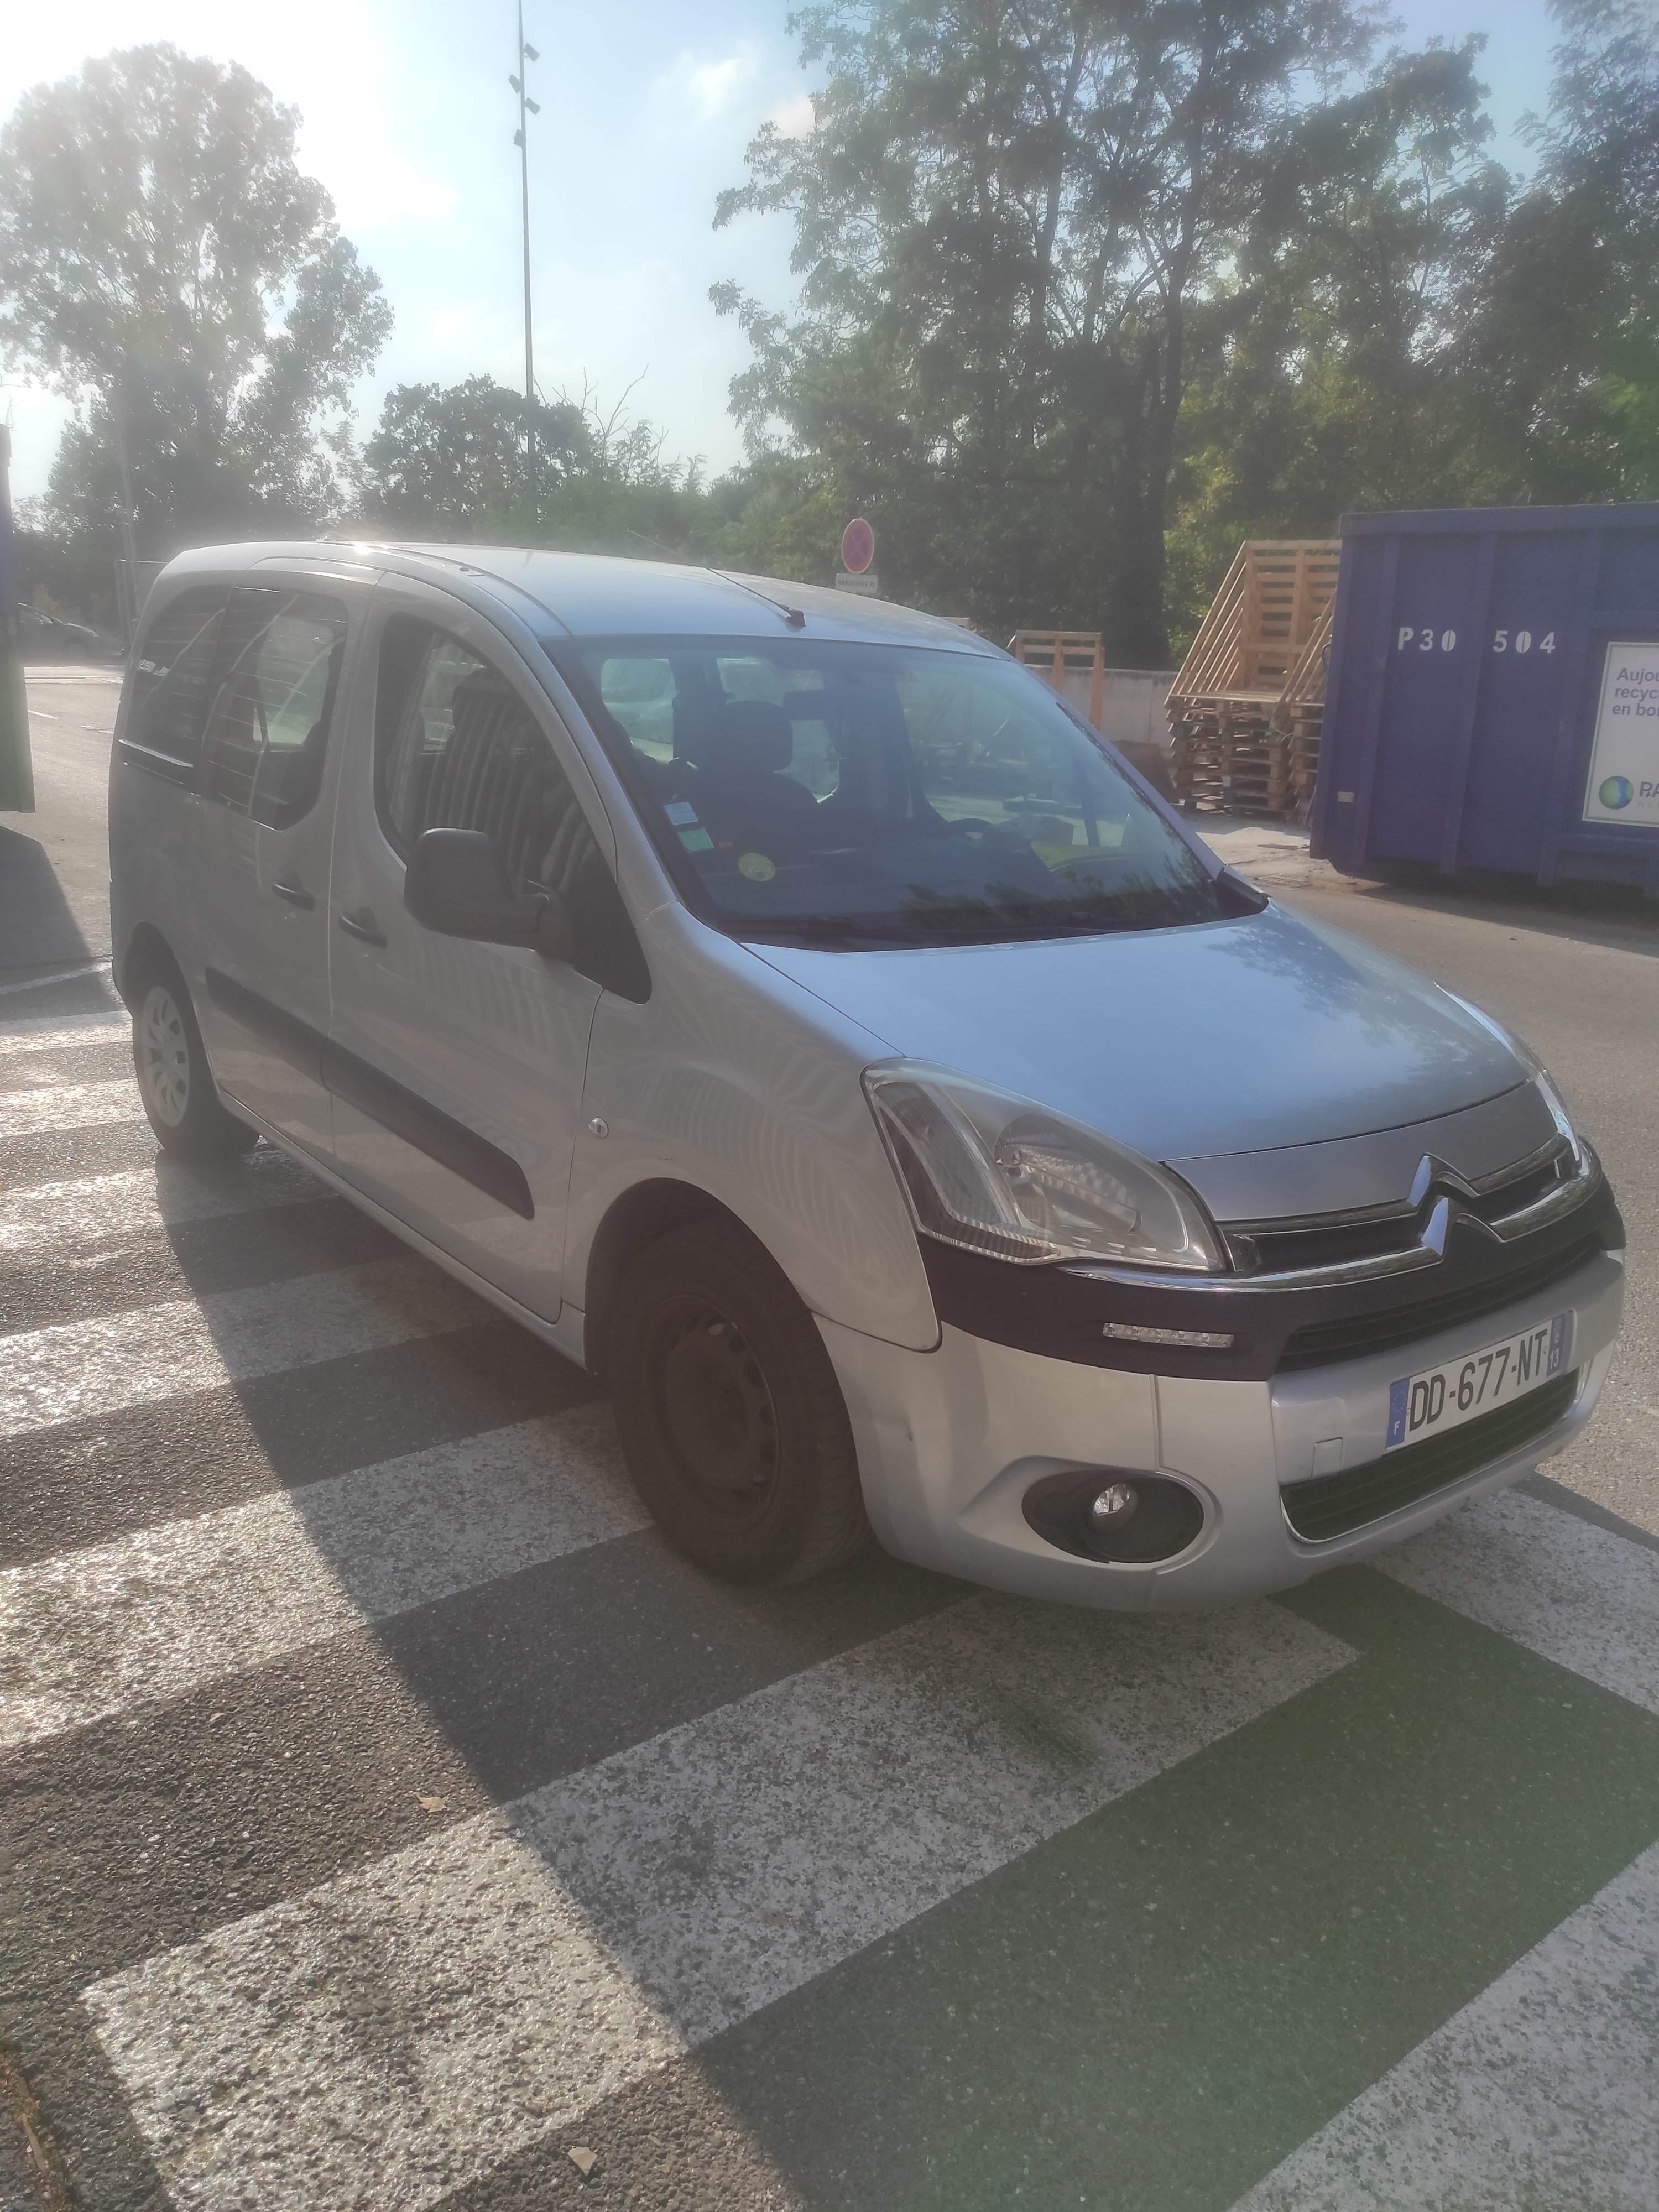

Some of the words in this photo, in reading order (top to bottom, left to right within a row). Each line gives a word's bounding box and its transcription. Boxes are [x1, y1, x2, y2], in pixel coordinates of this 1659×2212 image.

[1397, 627, 1456, 652] P30
[1493, 630, 1555, 654] 504
[1615, 688, 1659, 702] recyc
[1612, 705, 1631, 715] en
[1636, 703, 1659, 717] bo
[1394, 1420, 1400, 1436] F
[1408, 1328, 1548, 1432] DD-677-NT
[1549, 1348, 1560, 1370] 13
